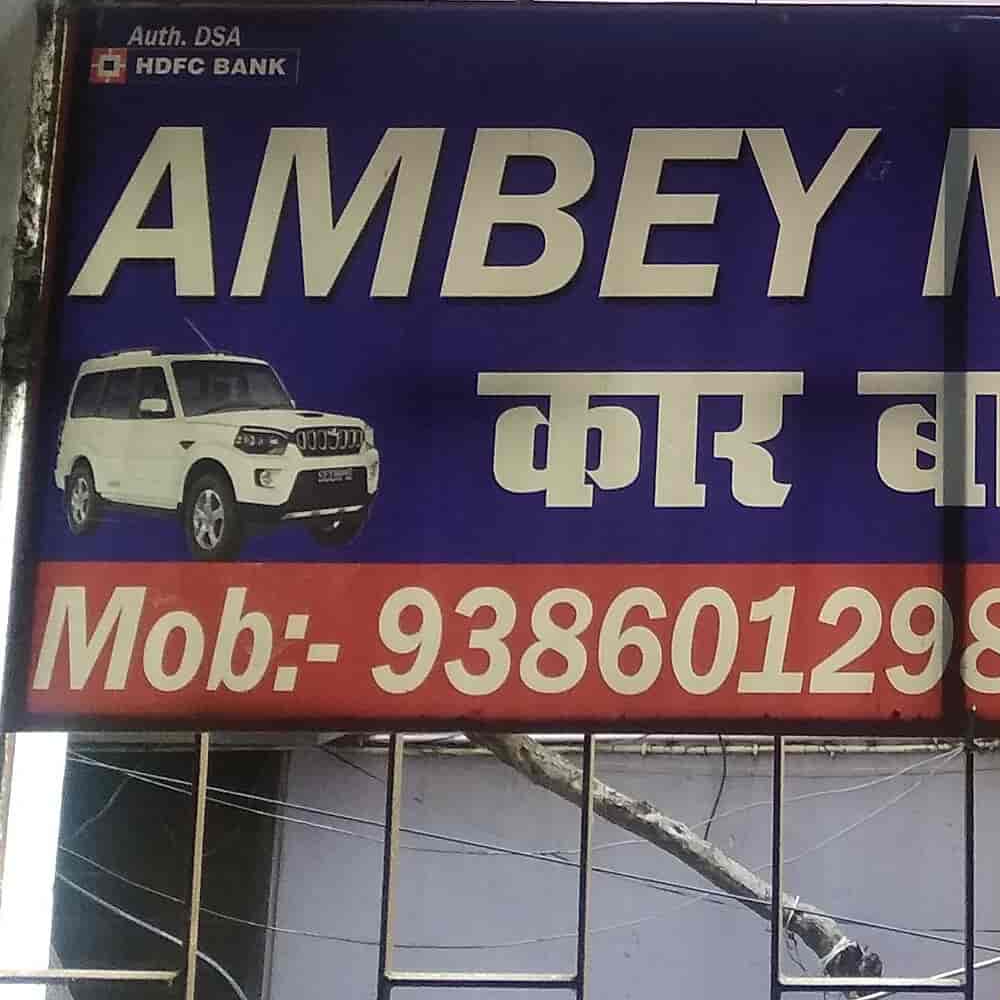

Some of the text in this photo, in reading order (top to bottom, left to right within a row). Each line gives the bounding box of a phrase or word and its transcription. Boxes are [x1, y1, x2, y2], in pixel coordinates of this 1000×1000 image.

[127, 25, 241, 47] Auth. DSA
[135, 57, 287, 75] HDFC BANK
[70, 126, 882, 298] AMBEY
[477, 371, 804, 508] कार
[32, 586, 341, 692] Mob:-
